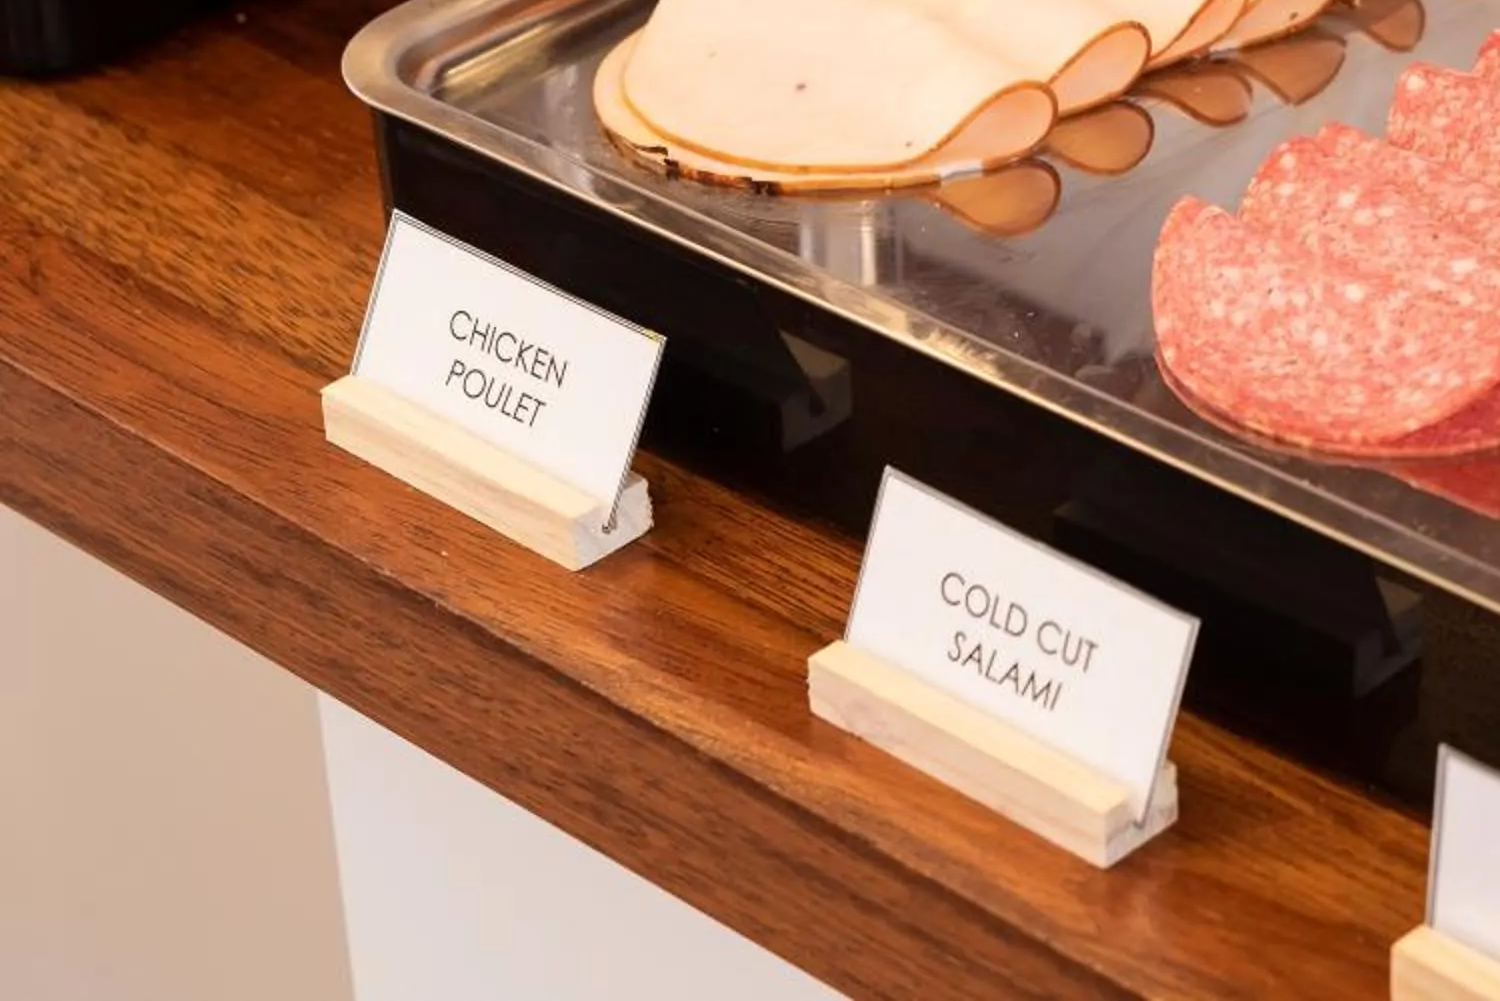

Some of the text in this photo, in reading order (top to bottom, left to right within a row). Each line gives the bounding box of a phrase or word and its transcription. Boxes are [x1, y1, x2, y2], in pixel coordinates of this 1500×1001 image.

[448, 309, 569, 390] CHICKEN
[444, 359, 547, 429] POULET
[939, 571, 1100, 674] COLD CUT
[946, 629, 1064, 712] SALAMI
